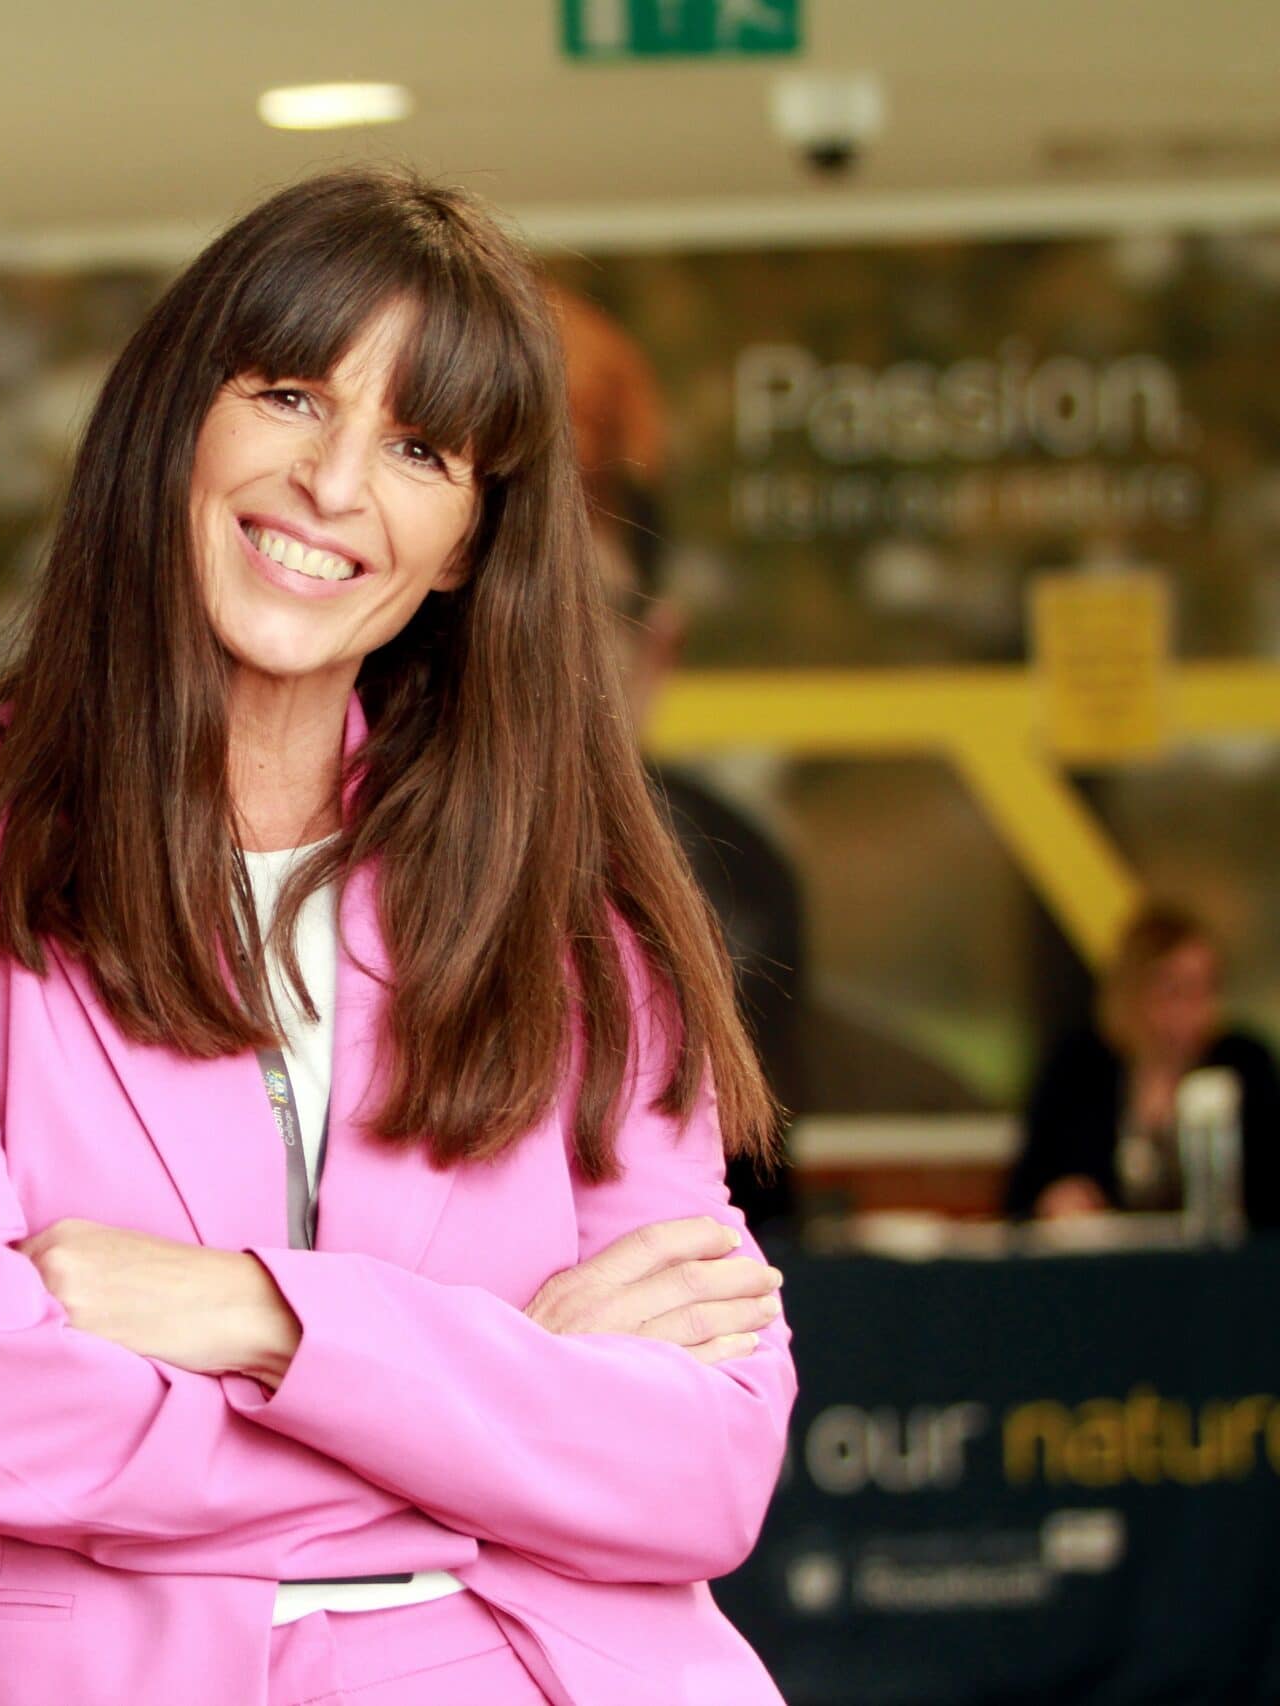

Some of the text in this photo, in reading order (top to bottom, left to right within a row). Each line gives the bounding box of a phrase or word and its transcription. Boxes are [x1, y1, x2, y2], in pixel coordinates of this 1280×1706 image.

[284, 1109, 295, 1146] College
[805, 1403, 987, 1494] our
[1002, 1383, 1280, 1488] natur
